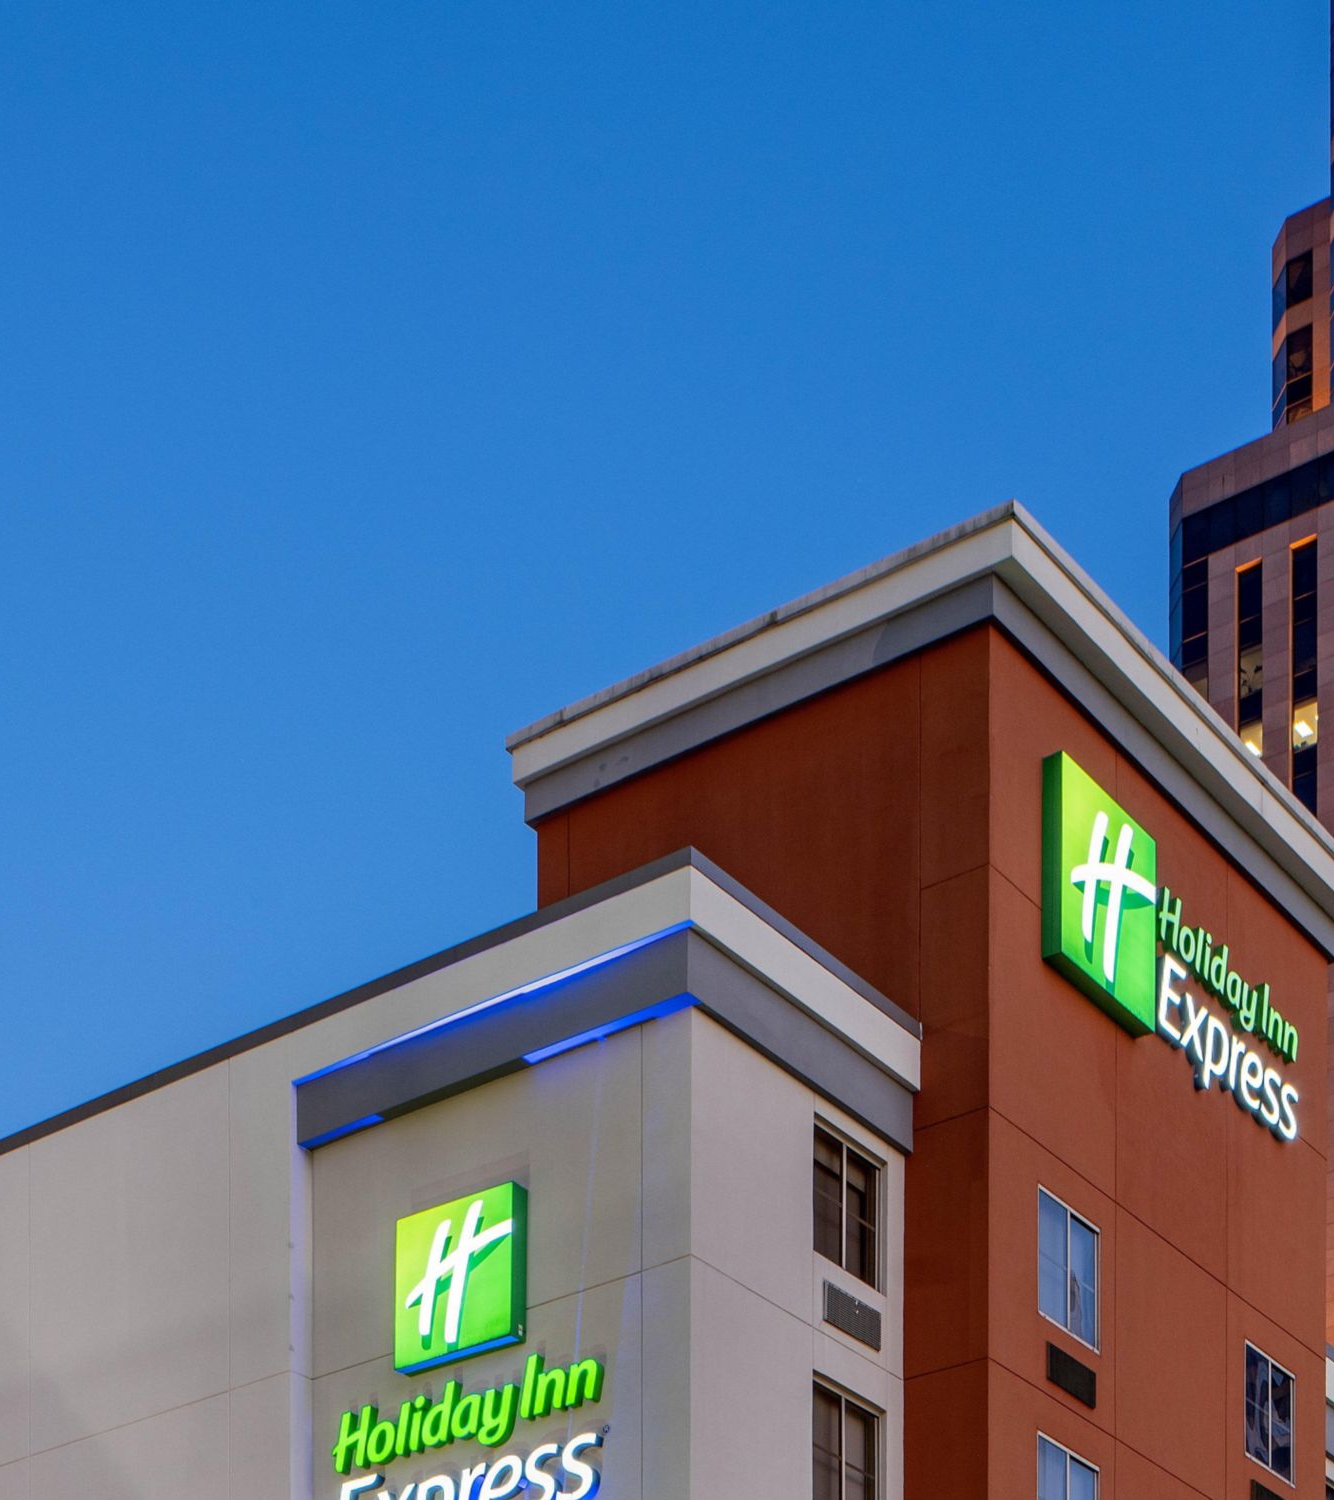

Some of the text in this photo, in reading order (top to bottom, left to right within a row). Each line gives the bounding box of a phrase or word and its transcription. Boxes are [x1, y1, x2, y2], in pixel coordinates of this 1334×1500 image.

[1158, 886, 1299, 1063] Holiday Inn
[1158, 953, 1299, 1141] Express
[331, 1354, 603, 1474] Holiday Inn
